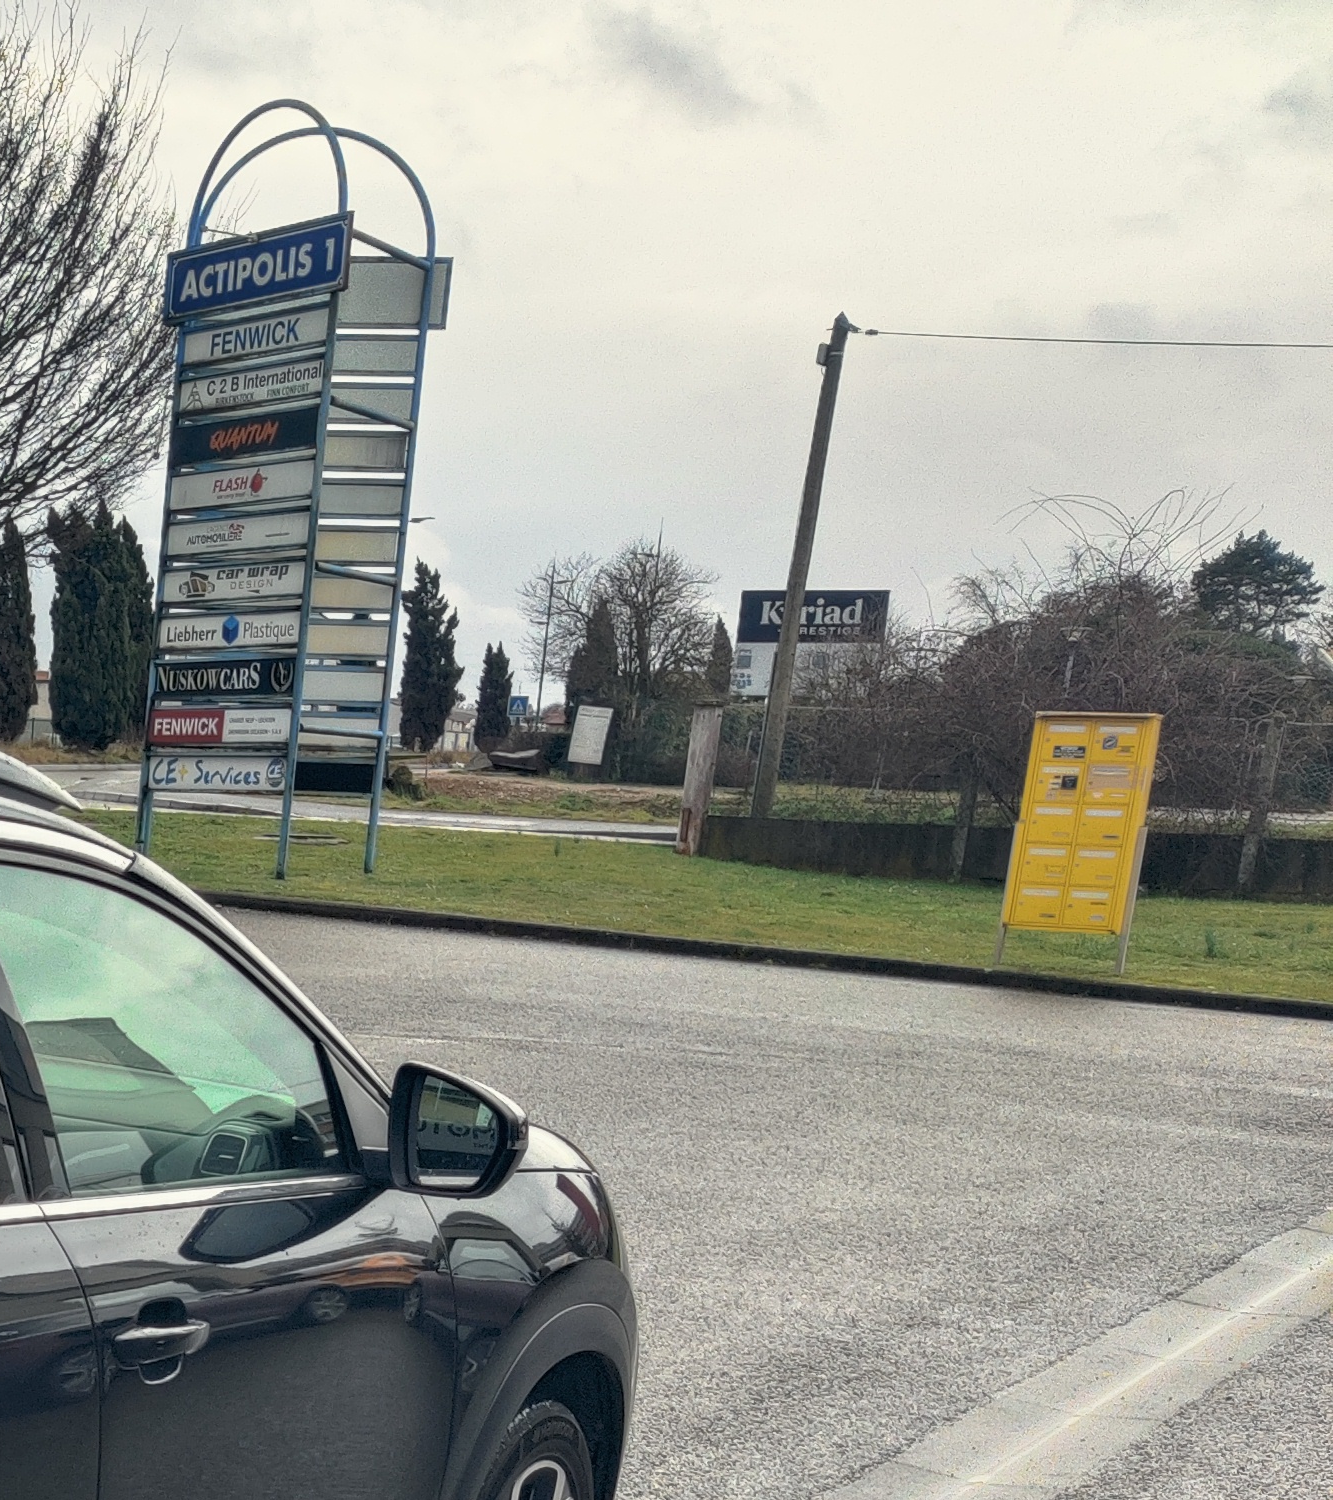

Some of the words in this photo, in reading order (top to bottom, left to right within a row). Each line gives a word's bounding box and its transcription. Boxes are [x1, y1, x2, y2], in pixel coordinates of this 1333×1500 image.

[179, 243, 312, 303] ACTIPOLIS
[325, 237, 336, 275] 1
[209, 317, 301, 358] FENWICK
[206, 380, 216, 396] C
[219, 378, 227, 394] 2
[230, 376, 240, 392] B
[243, 362, 323, 390] International
[266, 388, 281, 398] FINN
[209, 420, 280, 452] QUANTUM
[213, 475, 249, 493] FLASH
[216, 567, 245, 580] car
[247, 564, 290, 581] wrap
[229, 578, 274, 590] DESIGN
[759, 597, 864, 625] Kriad
[166, 626, 218, 644] Liebherr
[243, 620, 295, 646] Plastique
[798, 626, 862, 636] RESTIGE
[155, 662, 261, 693] NUSKOWCARS
[153, 717, 220, 736] FENWICK
[193, 760, 261, 785] Services
